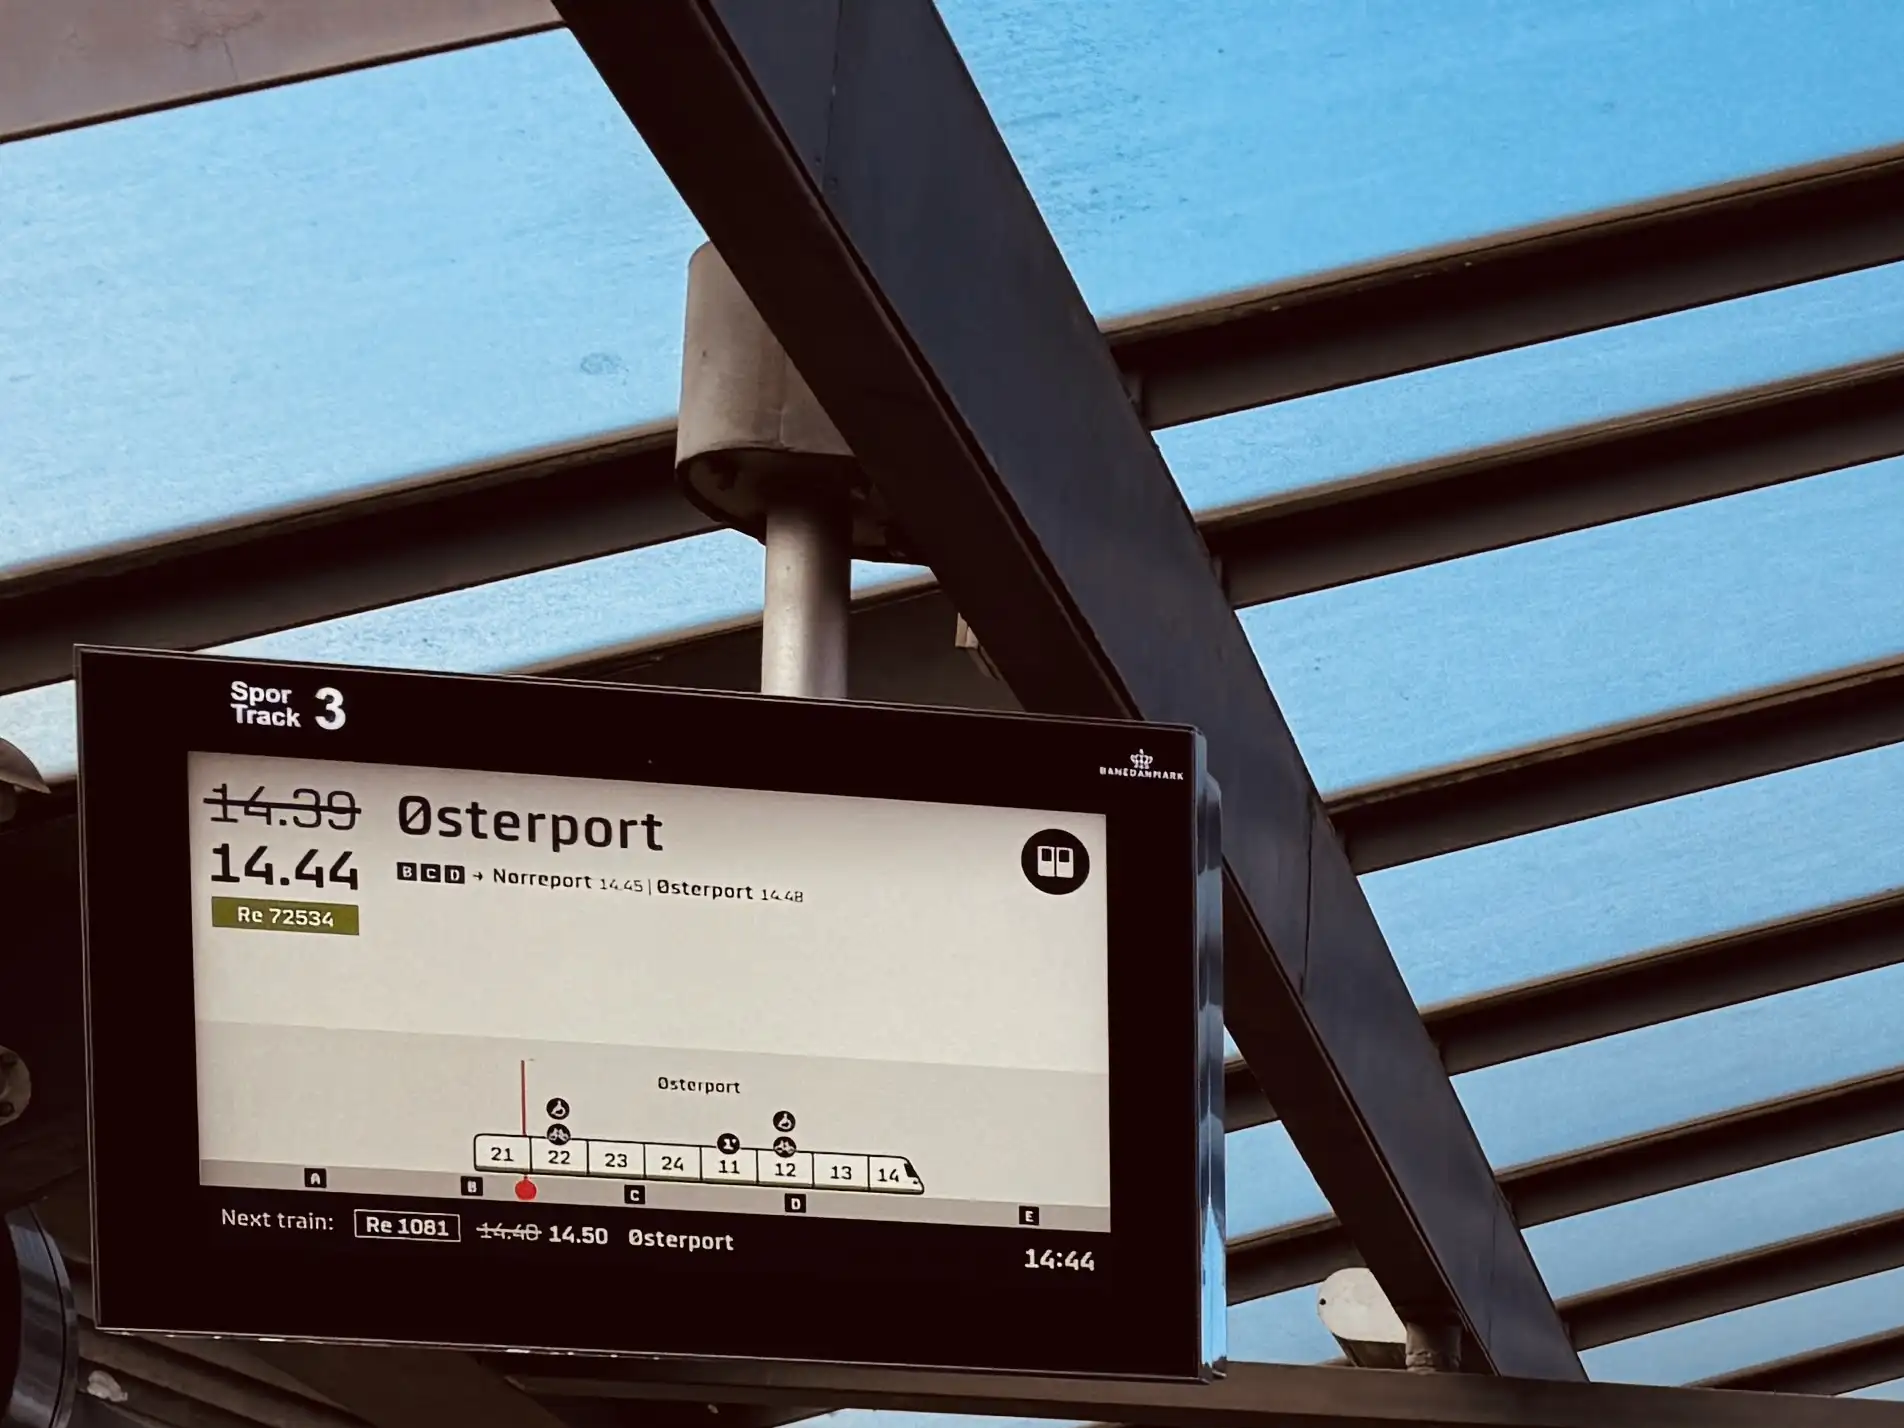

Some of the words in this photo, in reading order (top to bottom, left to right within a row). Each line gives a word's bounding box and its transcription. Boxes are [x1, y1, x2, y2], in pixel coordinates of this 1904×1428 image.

[231, 681, 292, 705] Spor
[231, 703, 301, 728] Track
[315, 686, 347, 731] 3
[1099, 766, 1184, 780] BANEDANMARK
[206, 783, 360, 831] 14.39
[398, 795, 664, 853] Østerport
[210, 843, 359, 891] 14.44
[657, 879, 754, 900] Østerport
[237, 906, 264, 923] Re
[269, 908, 335, 928] 72534
[490, 1147, 515, 1163] 21
[548, 1149, 571, 1165] 22
[604, 1153, 628, 1168] 23
[661, 1156, 685, 1172] 24
[718, 1159, 740, 1175] 11
[774, 1162, 797, 1178] 12
[831, 1165, 852, 1181] 13
[878, 1167, 900, 1183] 14
[221, 1208, 271, 1230] Next
[277, 1210, 334, 1231] train:
[366, 1216, 392, 1234] Re
[399, 1218, 449, 1237] 1081
[549, 1225, 608, 1244] 14.50
[628, 1228, 734, 1252] Østerport
[1024, 1248, 1095, 1271] 14:44
